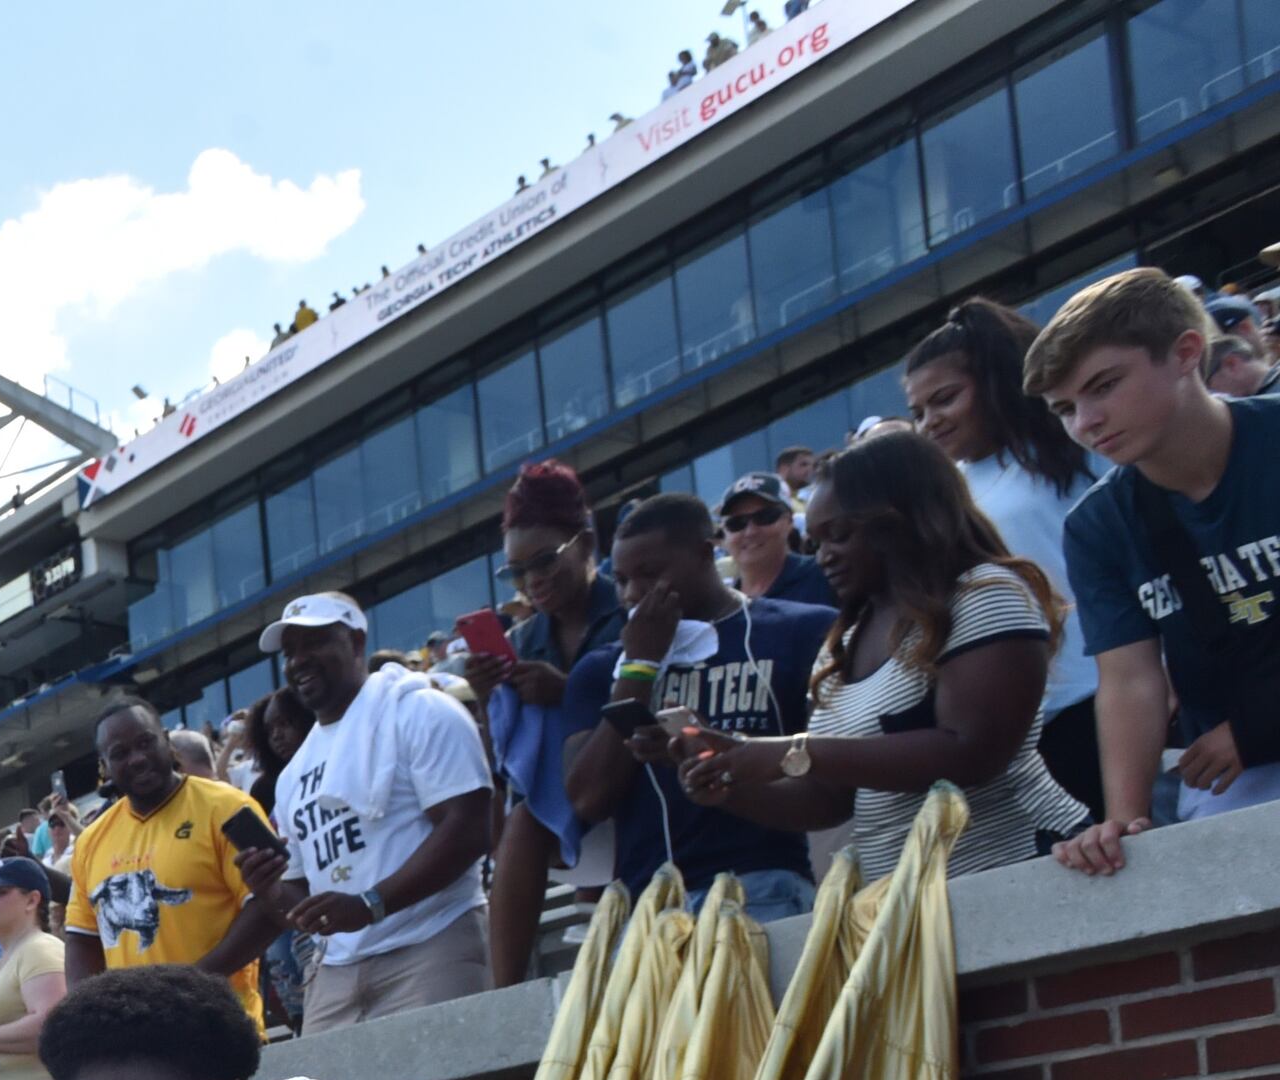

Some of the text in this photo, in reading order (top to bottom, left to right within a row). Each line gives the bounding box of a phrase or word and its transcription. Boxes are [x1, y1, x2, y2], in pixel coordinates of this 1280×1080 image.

[637, 22, 830, 151] Visit gucu.org
[365, 171, 568, 310] The Official Credit Union of
[377, 283, 435, 322] GEORGIA
[482, 205, 558, 260] ATHLETICS
[707, 659, 774, 717] TECH
[299, 759, 328, 801] TH
[313, 815, 367, 872] LIFE
